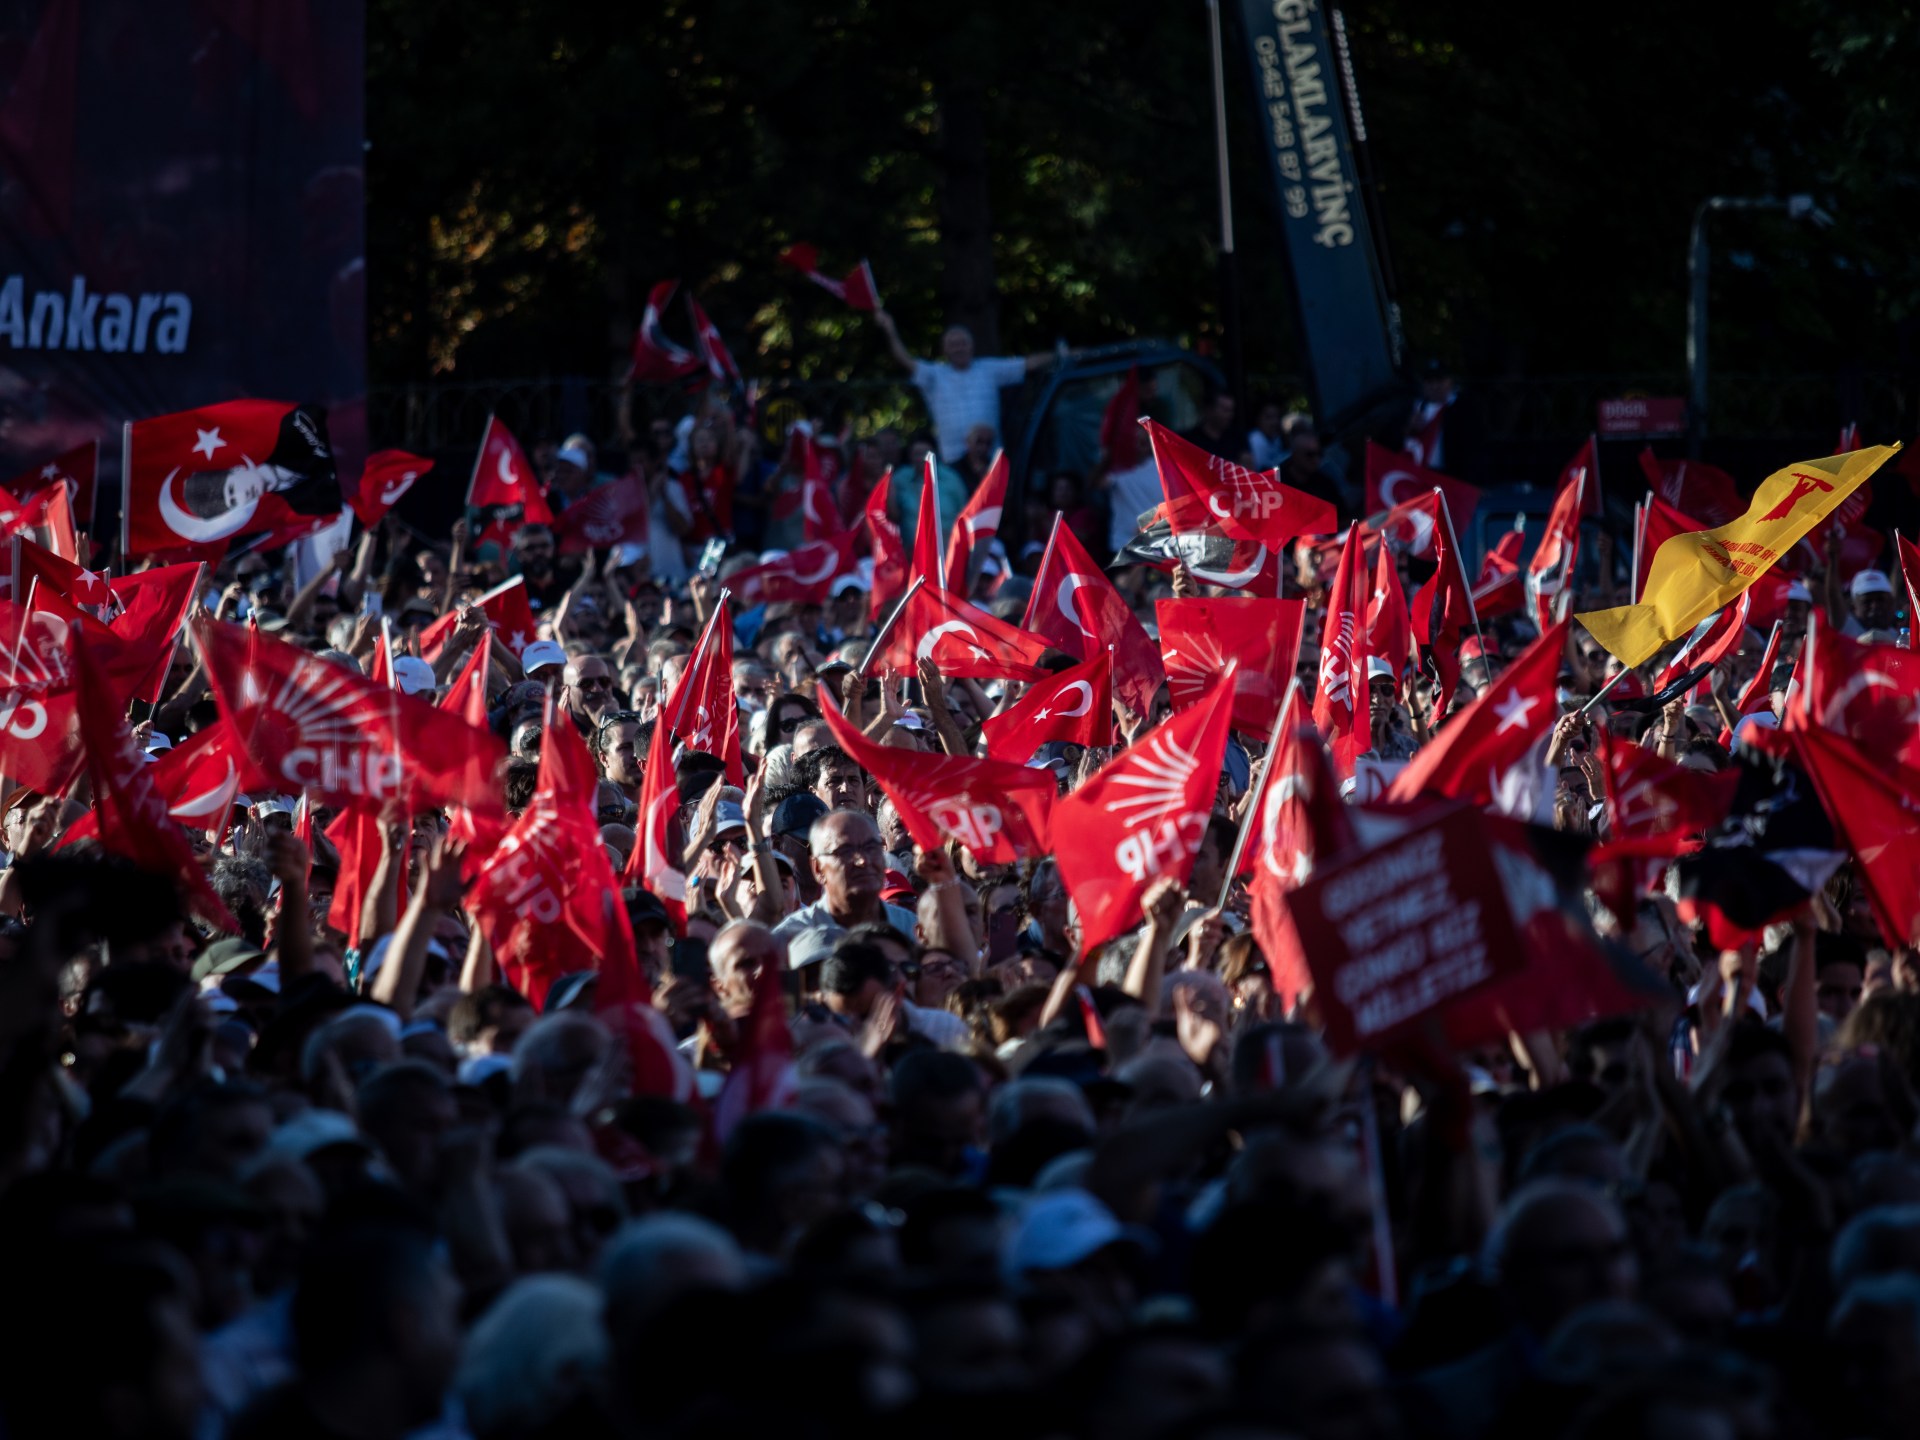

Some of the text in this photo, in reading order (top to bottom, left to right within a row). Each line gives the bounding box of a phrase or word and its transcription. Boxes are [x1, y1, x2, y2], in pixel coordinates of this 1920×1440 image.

[1254, 35, 1309, 219] 0542 548 87 99
[0, 274, 193, 354] Ankara
[1208, 491, 1284, 519] CHP
[280, 745, 401, 799] CHP
